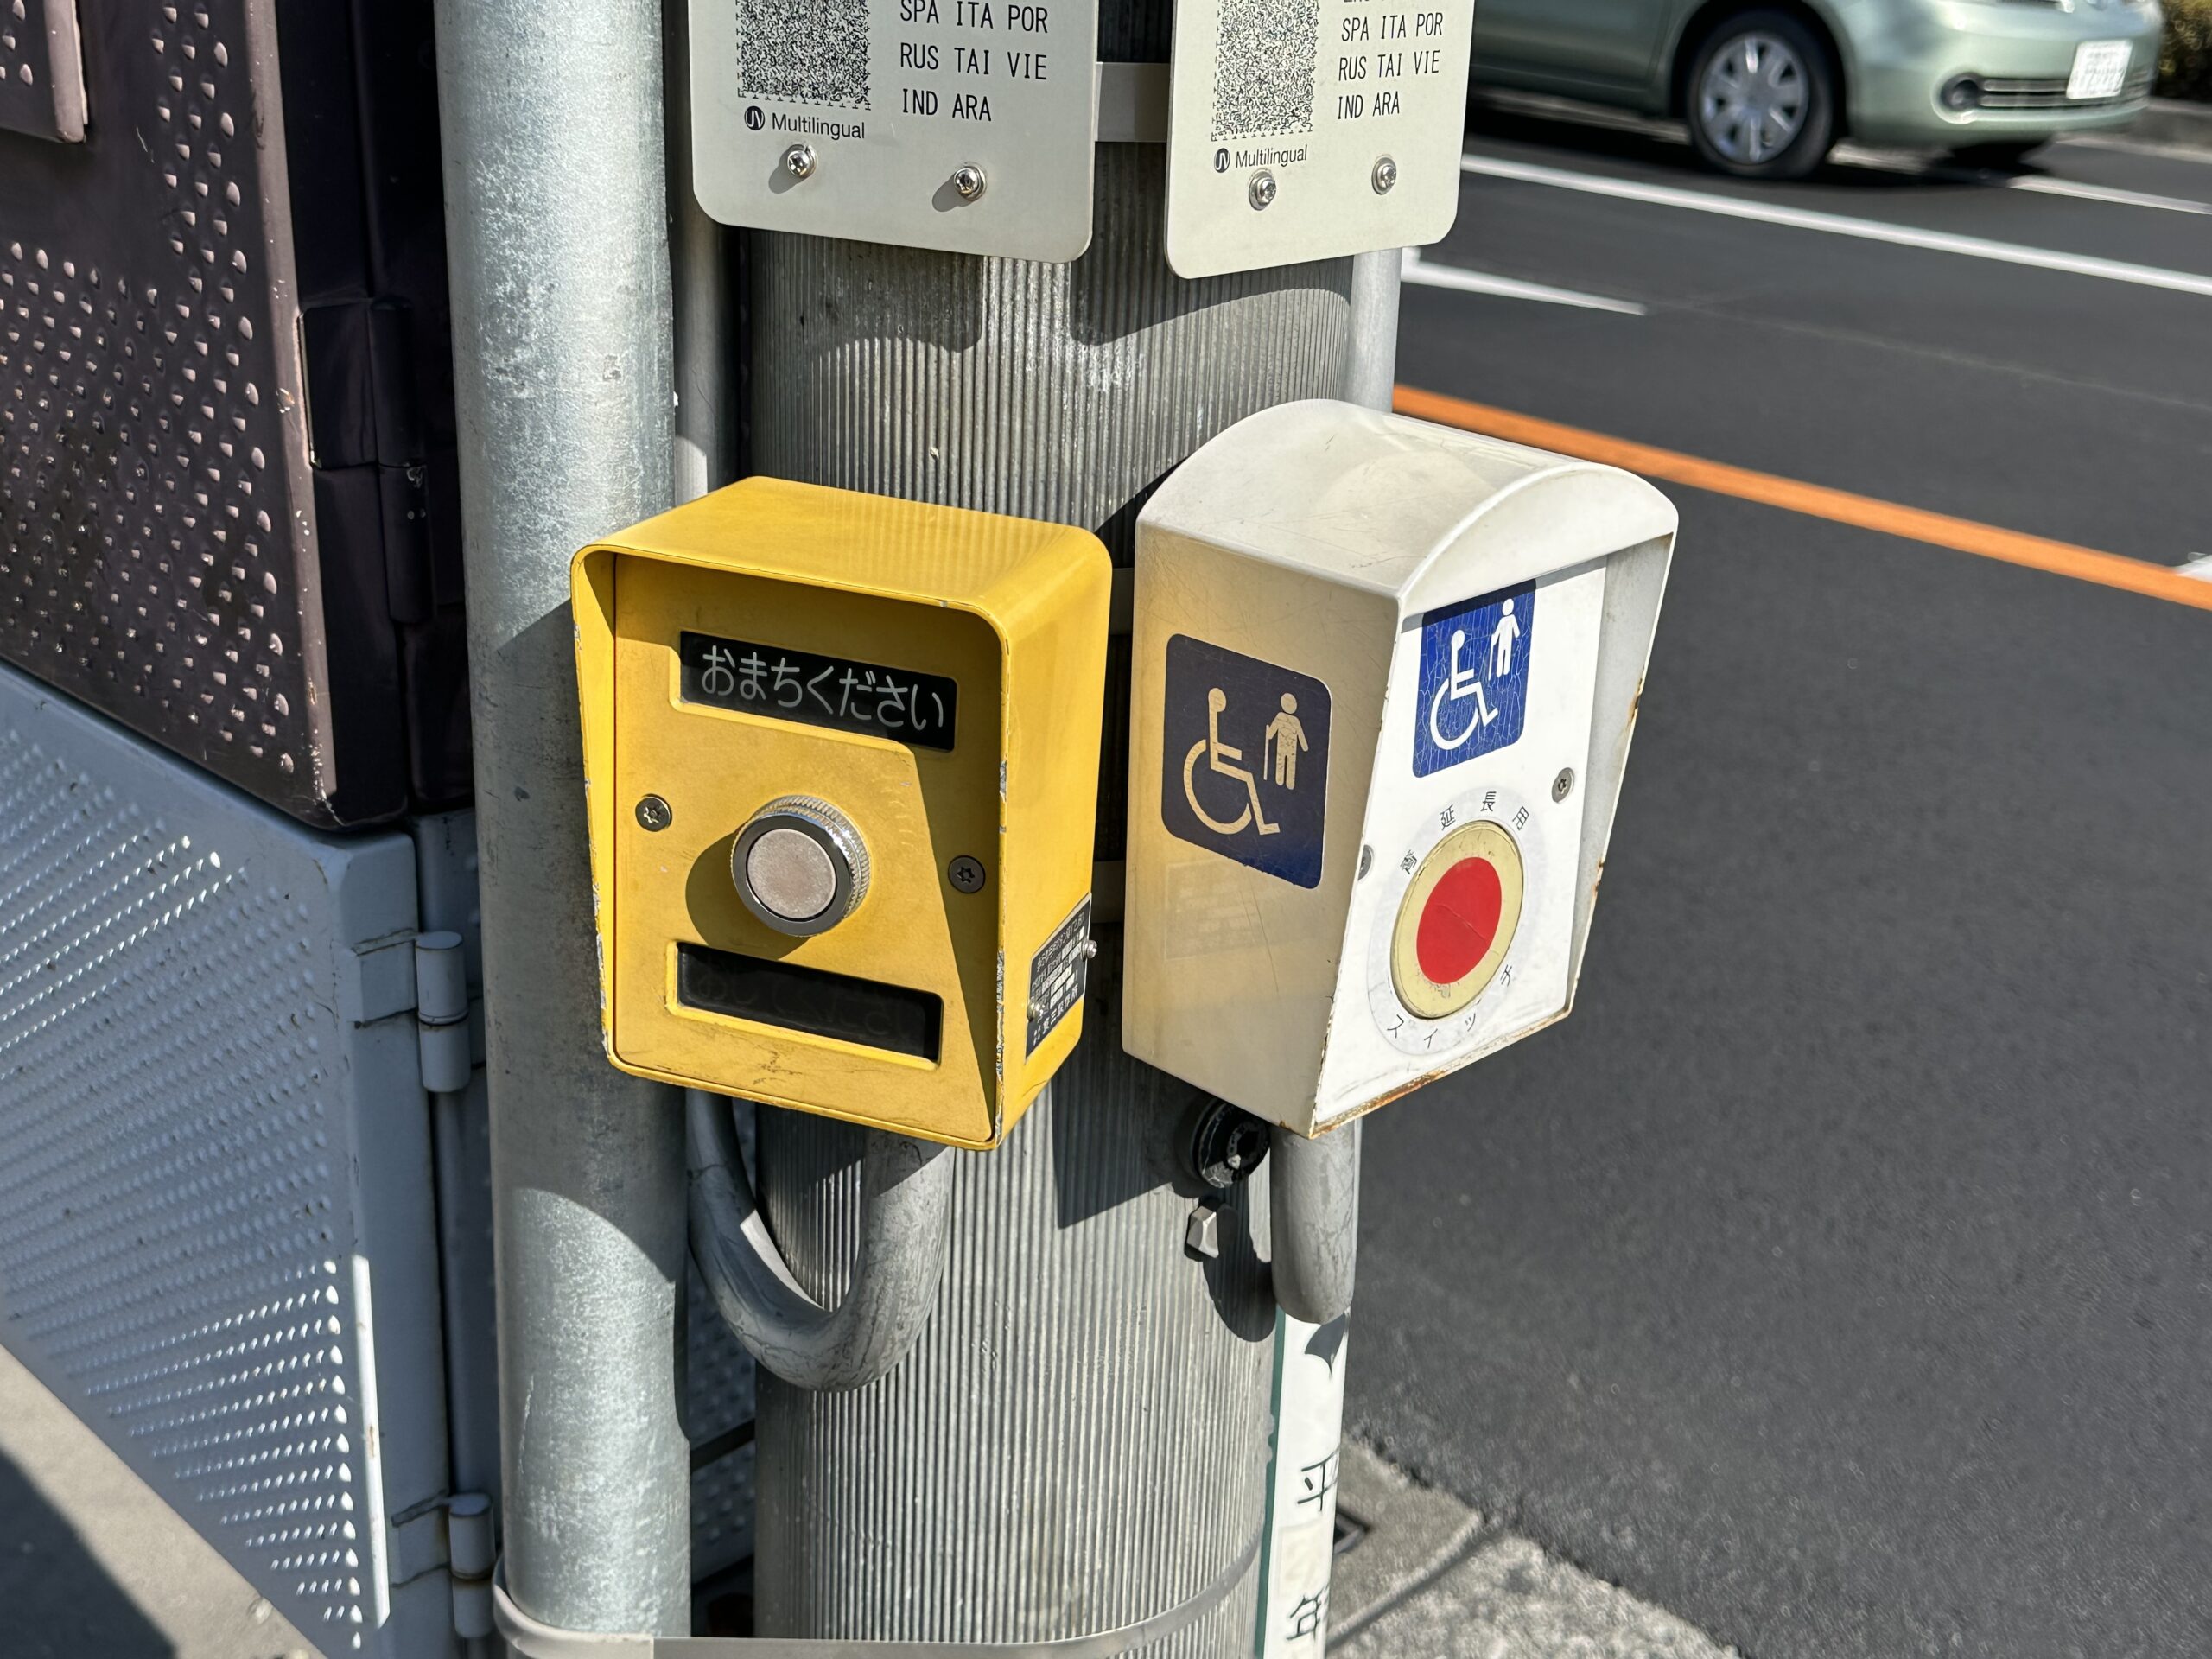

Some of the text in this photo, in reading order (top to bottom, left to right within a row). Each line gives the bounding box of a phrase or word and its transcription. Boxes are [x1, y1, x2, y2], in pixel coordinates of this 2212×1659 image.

[900, 0, 1048, 33] SPA ITA POR
[1341, 12, 1443, 41] SPA ITA POR
[900, 42, 1047, 80] RUS TAI VIE
[1338, 50, 1440, 81] RUS TAI VIE
[903, 88, 992, 122] IND ARA
[1338, 91, 1400, 119] IND ARA
[772, 112, 865, 141] Multilingual
[1236, 144, 1308, 168] Multilingual
[702, 645, 944, 731] おまちください
